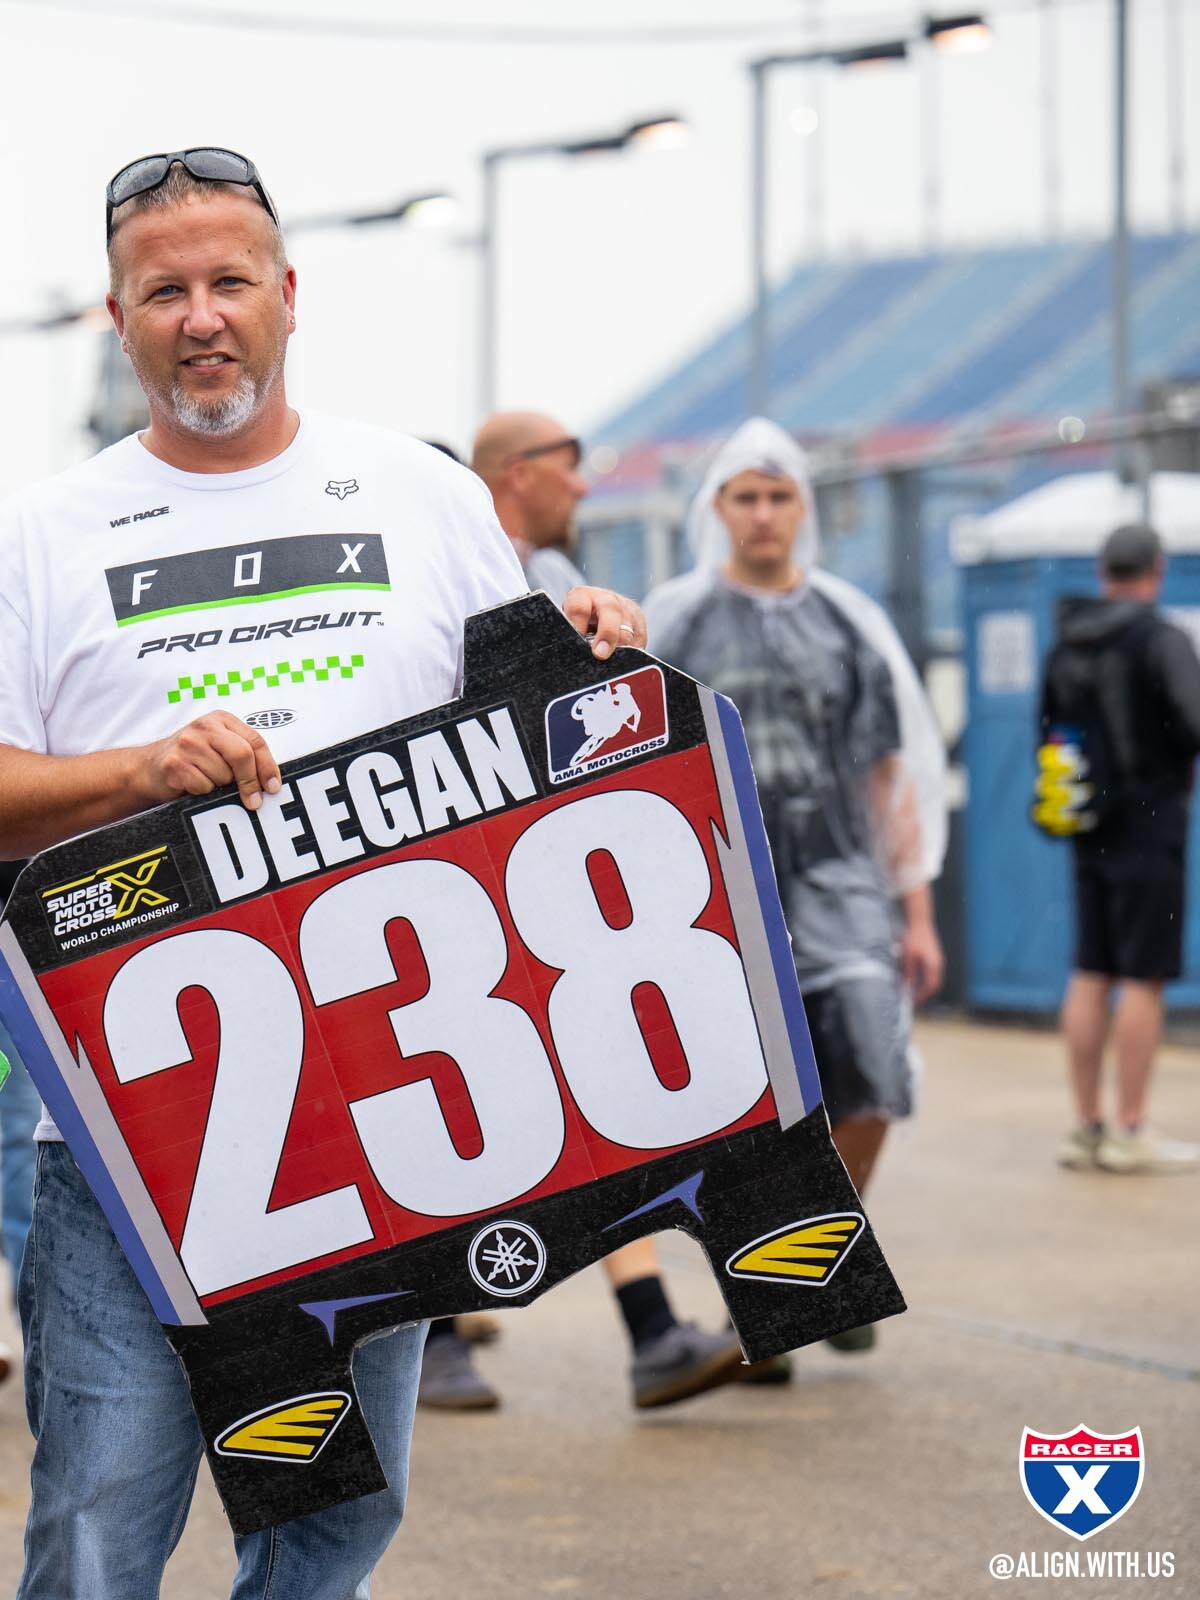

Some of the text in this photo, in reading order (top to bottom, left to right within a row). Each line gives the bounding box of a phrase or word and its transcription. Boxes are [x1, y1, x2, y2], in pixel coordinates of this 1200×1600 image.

[109, 506, 170, 528] WE RACE
[131, 542, 366, 606] FOX
[137, 629, 224, 659] PRO
[228, 611, 382, 645] CIRCUIT
[554, 737, 665, 782] AMA MOTOCROSS
[191, 713, 537, 903] DEEGAN
[46, 881, 112, 913] SUPER
[54, 904, 118, 936] CROSS
[55, 893, 113, 923] MOTO
[60, 902, 180, 951] WORLD CHAMPIONSHIP
[103, 788, 771, 1298] 238
